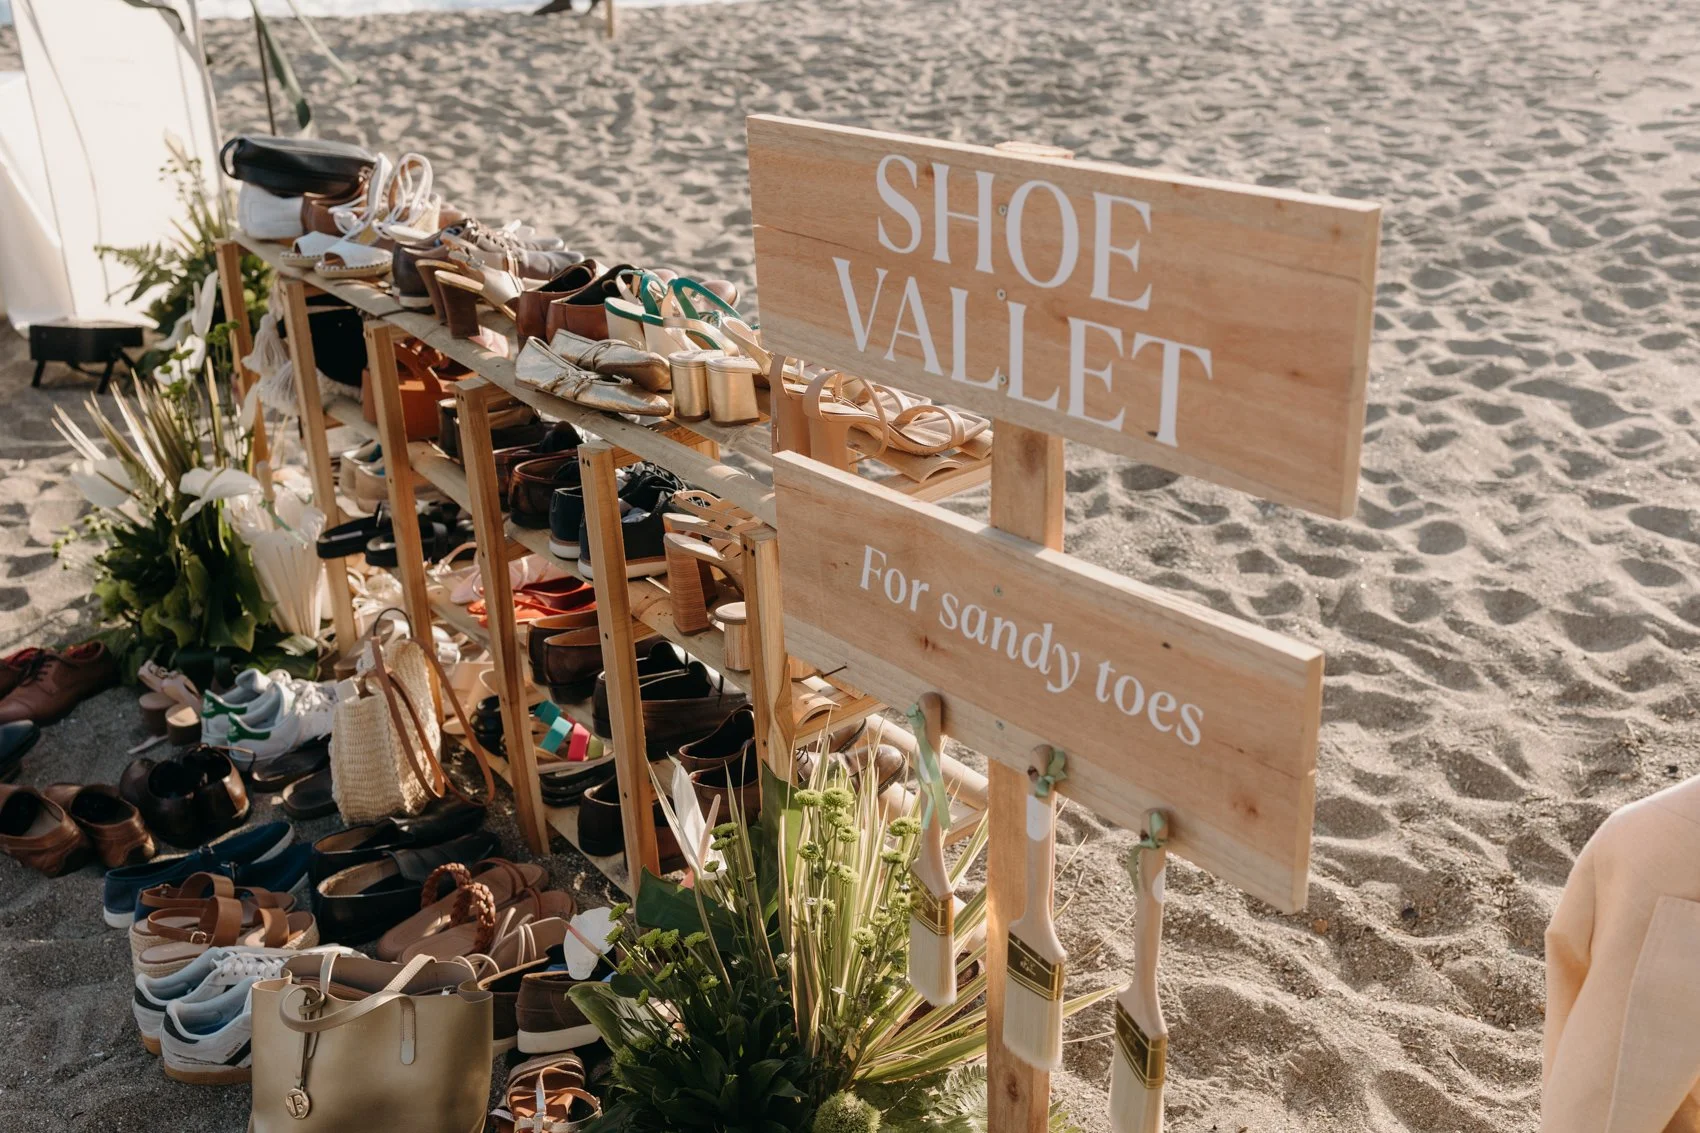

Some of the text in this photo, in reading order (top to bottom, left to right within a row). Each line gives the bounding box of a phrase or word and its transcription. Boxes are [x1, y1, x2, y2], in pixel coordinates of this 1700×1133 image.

[875, 154, 1153, 311] SHOE
[832, 256, 1213, 448] VALLET
[859, 544, 1205, 747] For sandy toes
